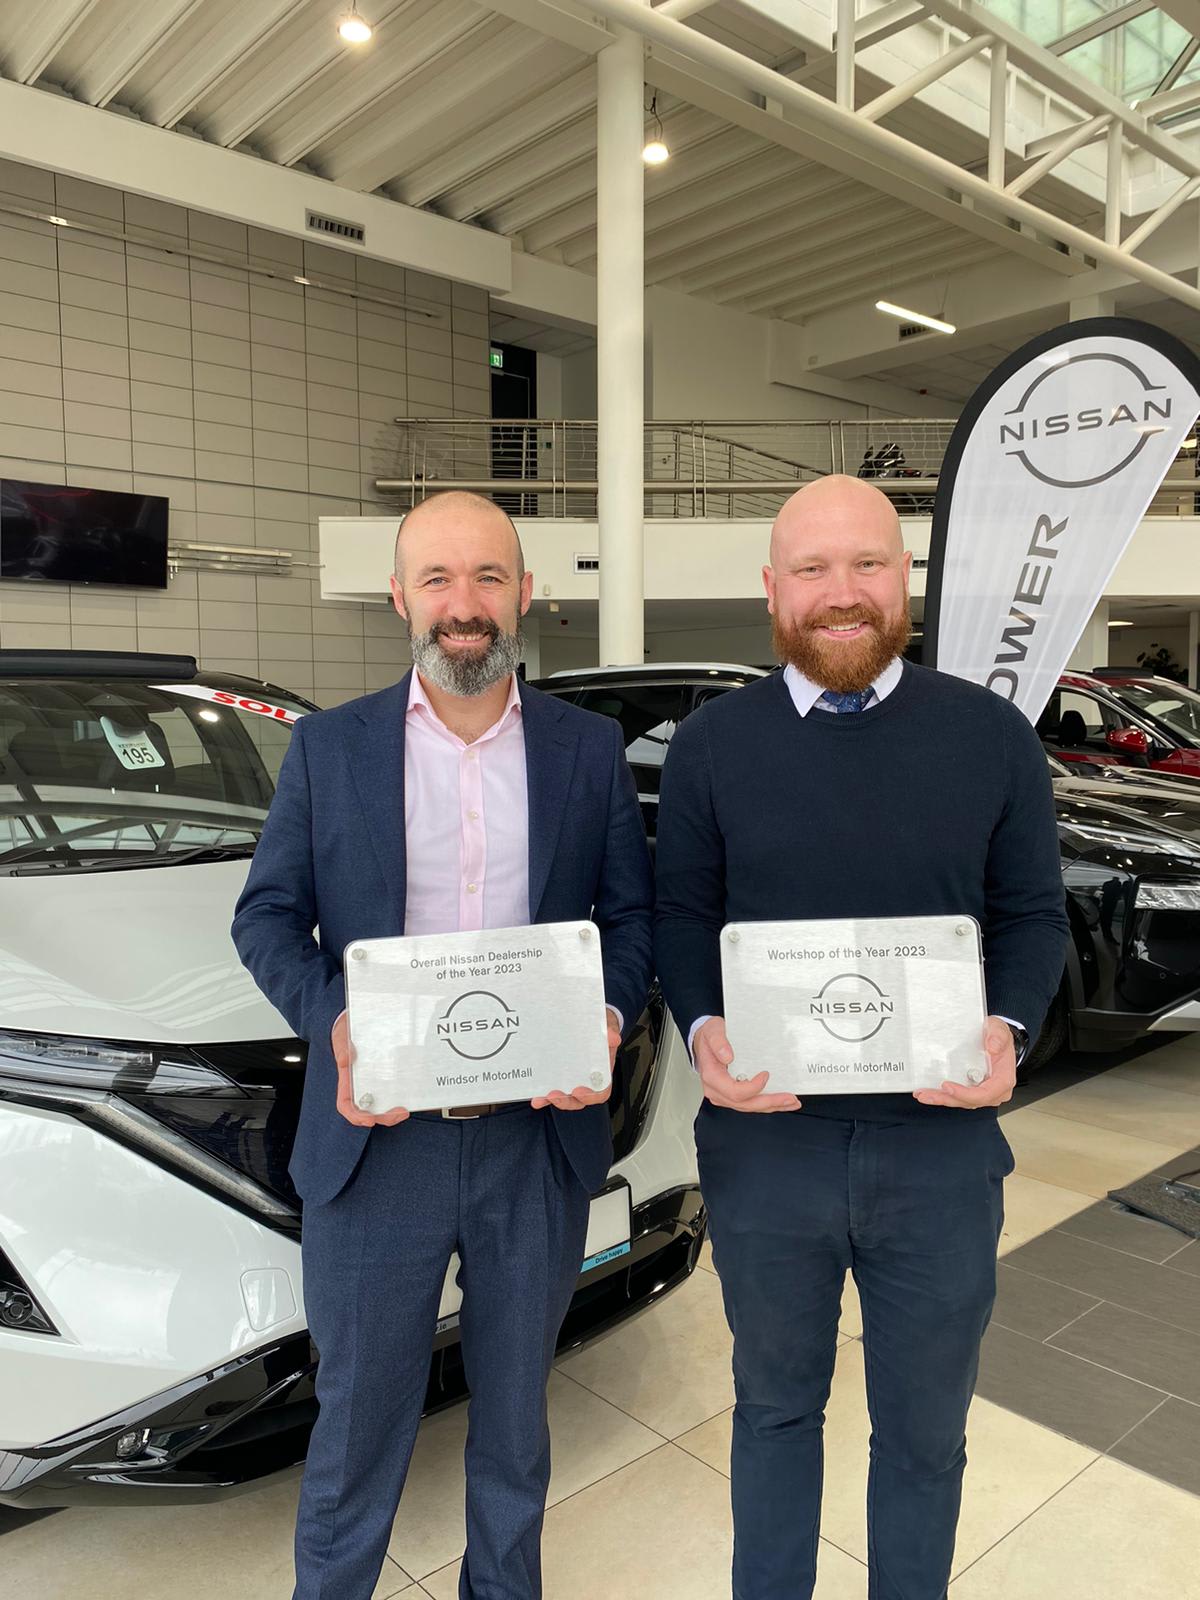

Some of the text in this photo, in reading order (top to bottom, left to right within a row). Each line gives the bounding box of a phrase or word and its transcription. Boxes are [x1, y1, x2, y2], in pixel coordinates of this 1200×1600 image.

[1000, 398, 1172, 444] NISSAN
[122, 747, 155, 765] 195
[410, 948, 543, 969] Overall Nissan Dealership
[767, 945, 926, 960] Workshop of the Year 2023
[436, 962, 522, 980] of the Year 2023
[810, 1001, 894, 1014] NISSAN
[437, 1016, 520, 1034] NISSAN
[807, 1061, 905, 1074] Windsor MotorMall
[436, 1067, 533, 1087] Windsor MotorMall
[595, 1247, 624, 1264] Drive happy
